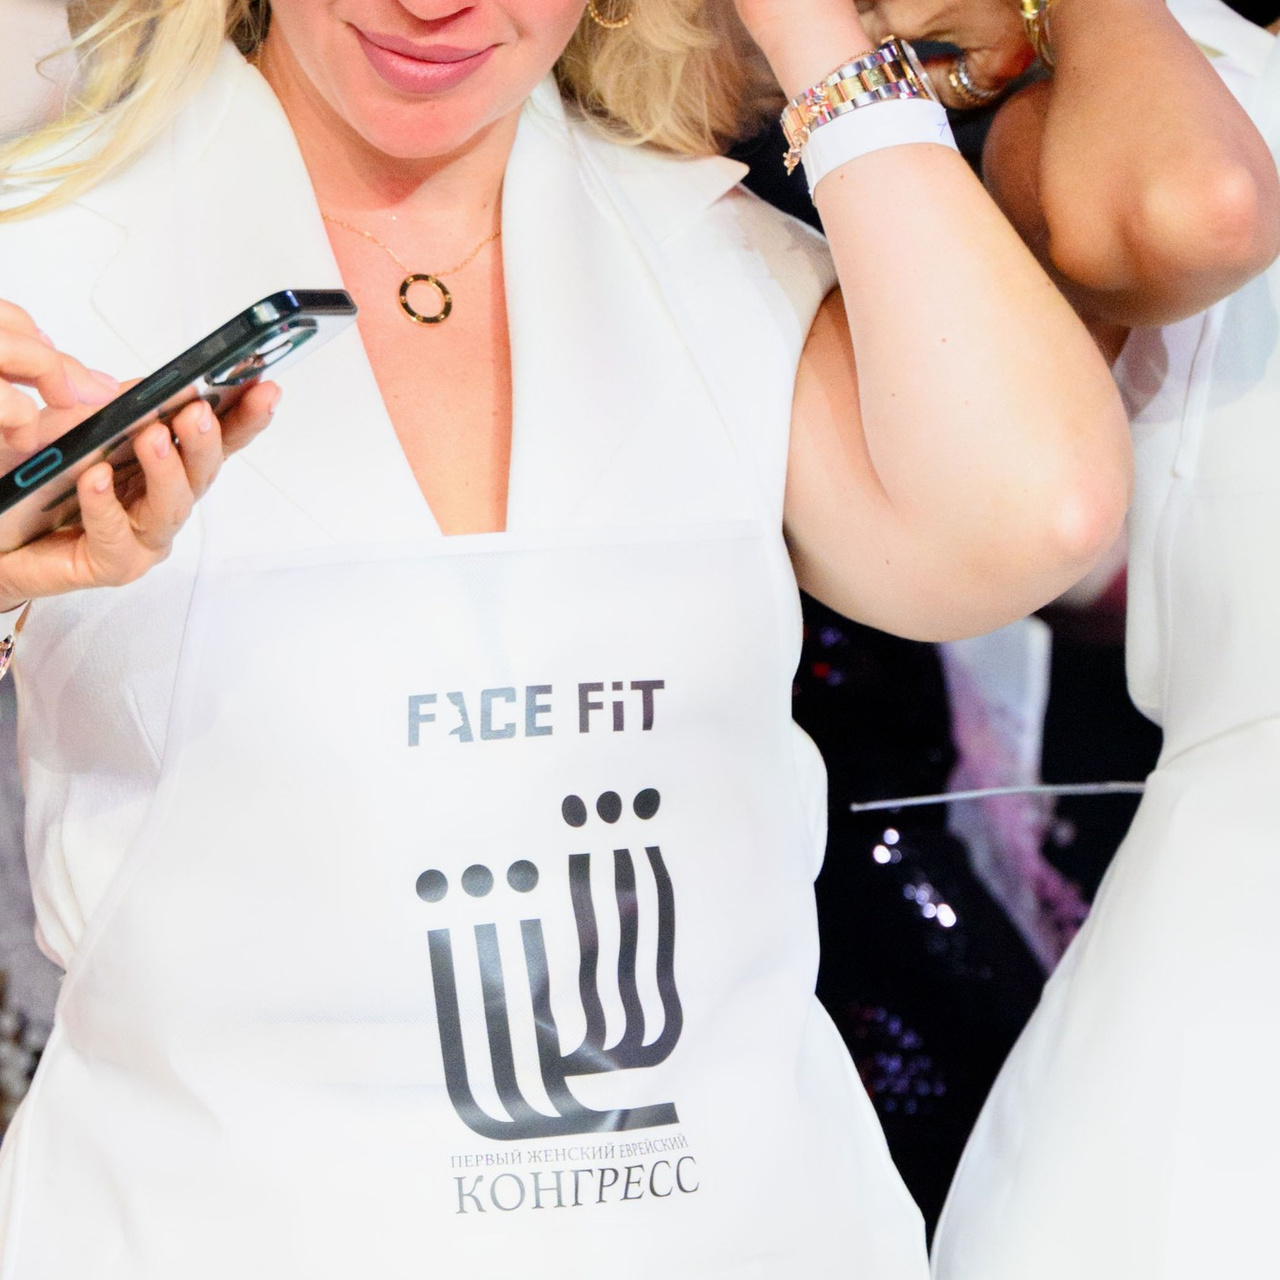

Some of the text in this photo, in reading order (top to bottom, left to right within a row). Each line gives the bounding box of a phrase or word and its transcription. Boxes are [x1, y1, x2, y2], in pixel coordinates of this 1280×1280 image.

[407, 684, 553, 747] FACE
[450, 1133, 689, 1168] ПЕРВЫЙ ЖЕНСКИЙ ЕВРЕЙСКИЙ
[453, 1155, 700, 1215] КОНГРЕСС
